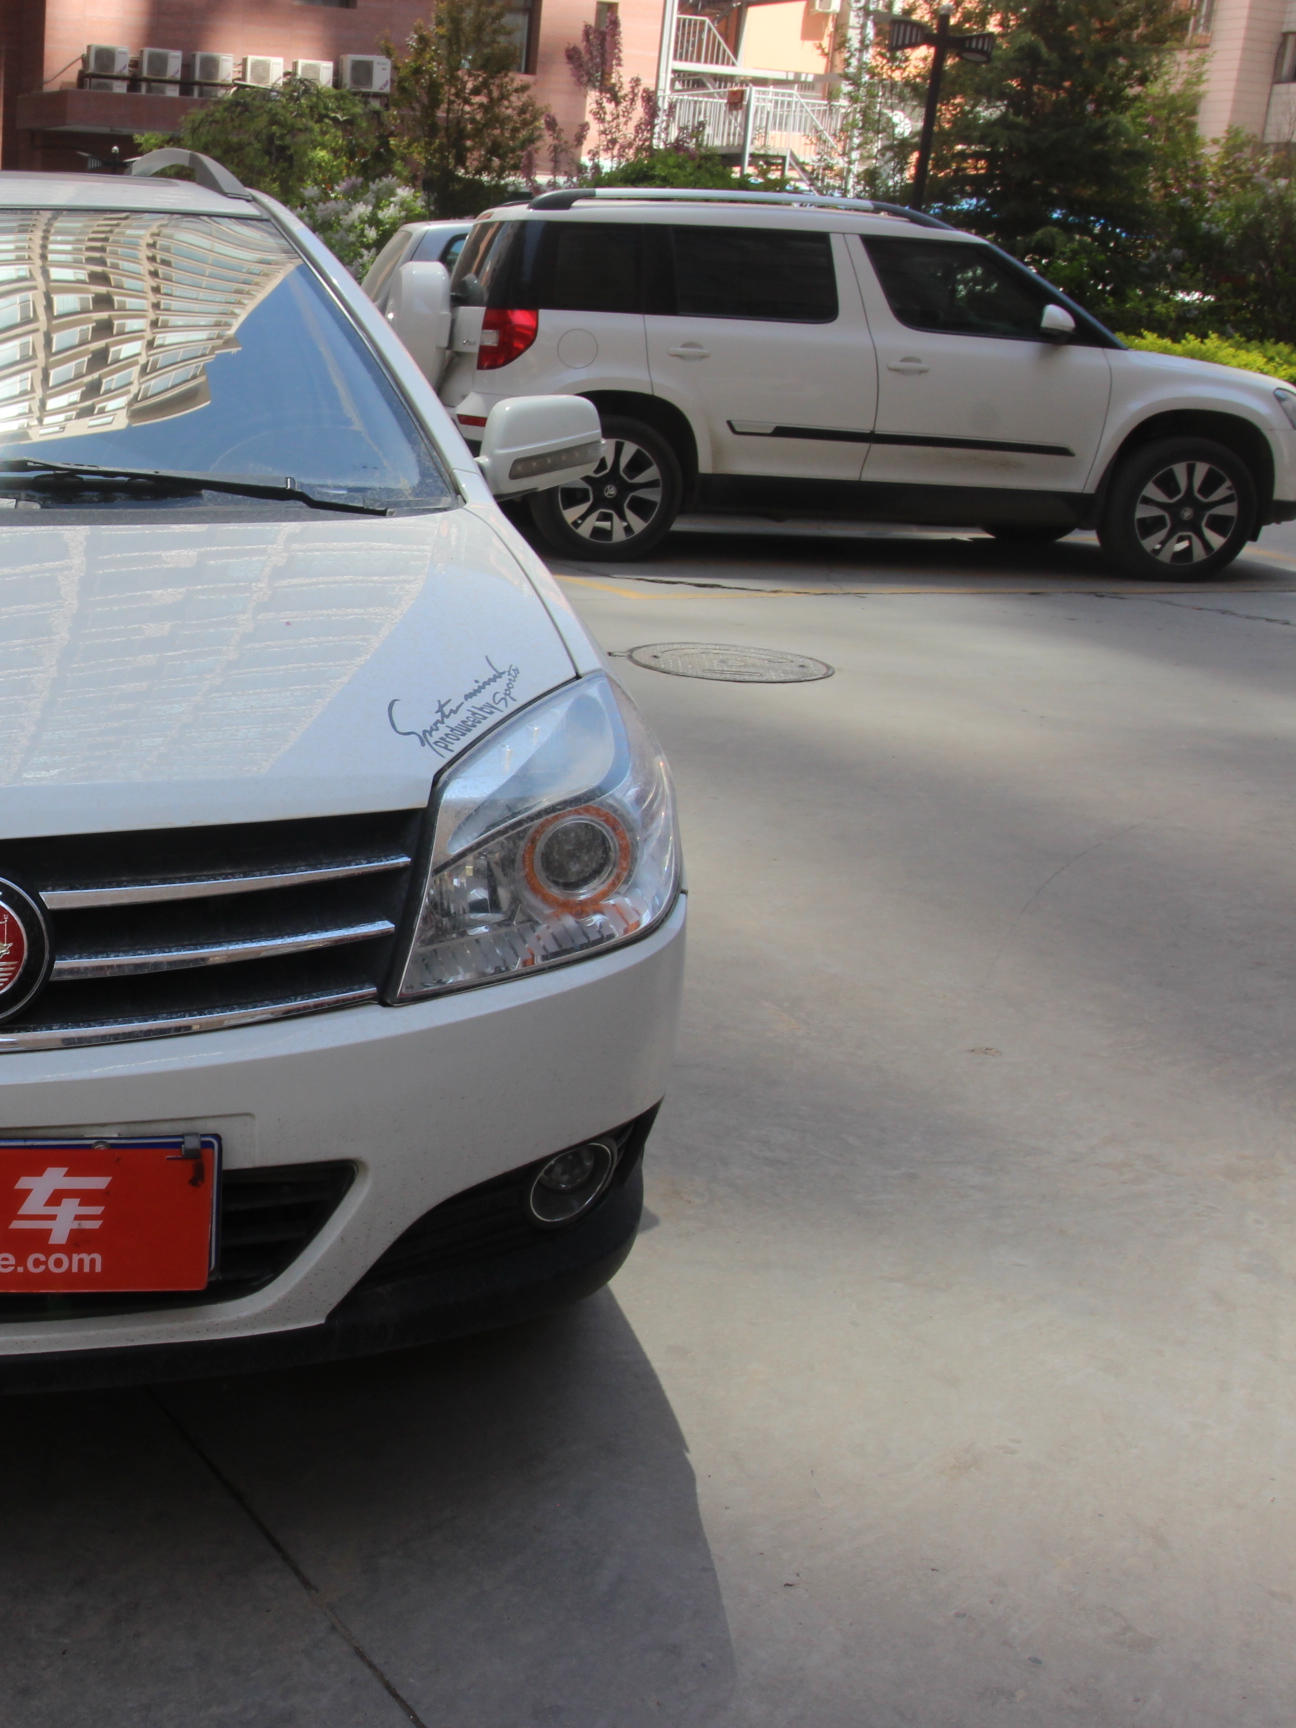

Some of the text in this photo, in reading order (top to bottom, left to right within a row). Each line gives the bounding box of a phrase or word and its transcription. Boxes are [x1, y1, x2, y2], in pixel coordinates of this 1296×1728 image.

[432, 708, 490, 753] produced
[492, 664, 520, 708] Sports
[463, 655, 506, 701] mind
